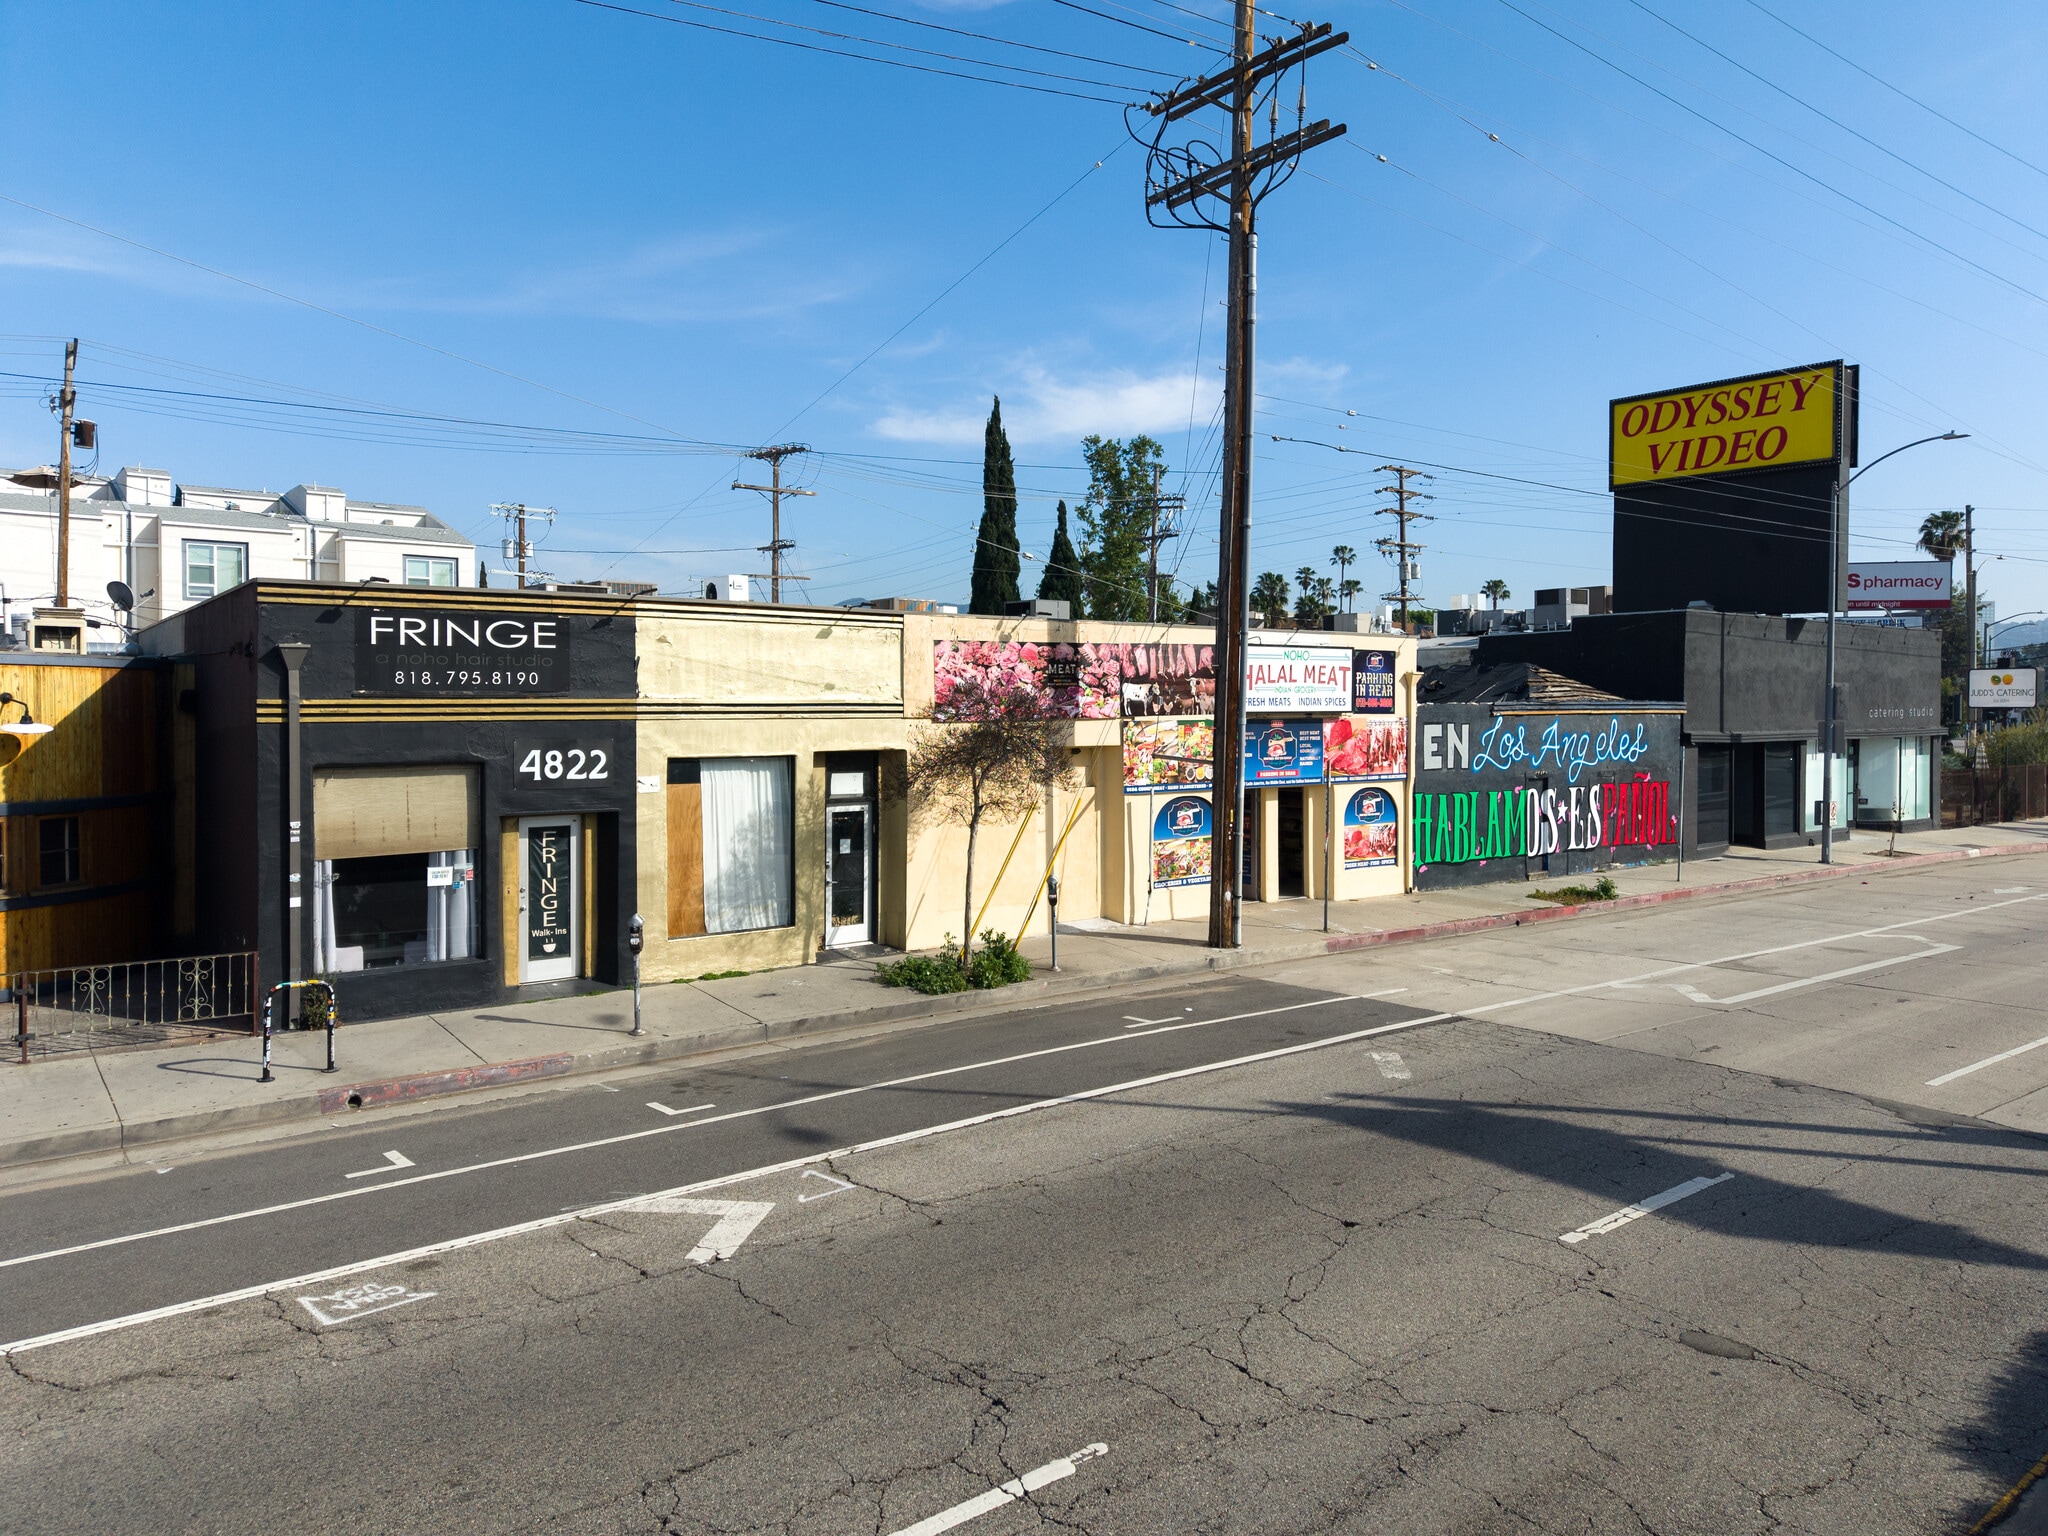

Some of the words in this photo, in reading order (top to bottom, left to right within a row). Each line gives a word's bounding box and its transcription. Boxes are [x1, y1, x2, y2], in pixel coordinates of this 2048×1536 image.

[1621, 374, 1823, 438] ODYSSEY
[1648, 425, 1788, 475] VIDEO
[1864, 575, 1944, 591] pharmacy
[1871, 601, 1901, 609] midnight
[370, 616, 557, 649] FRINGE
[375, 653, 389, 664] a
[396, 652, 450, 666] noho
[455, 653, 492, 667] hair
[498, 653, 554, 668] studio
[1283, 650, 1310, 661] NOHO
[1048, 663, 1077, 674] MEAT
[394, 670, 539, 685] 818.795.8190
[1303, 664, 1351, 692] MEAT
[1355, 672, 1393, 685] PARKING
[1294, 686, 1317, 694] GROCERY
[1355, 684, 1366, 696] IN
[1368, 685, 1393, 697] REAR
[1970, 688, 1995, 697] JUDD'S
[1996, 688, 2035, 697] CATERING
[1268, 697, 1292, 707] MEATS
[1298, 697, 1322, 707] INDIAN
[1324, 697, 1346, 707] SPICES
[1868, 707, 1904, 719] catering
[1909, 706, 1934, 717] studio
[1423, 723, 1470, 771] EN
[1472, 715, 1530, 774] Los
[1530, 715, 1649, 784] Angeles
[519, 749, 608, 781] 4822
[1412, 786, 1560, 873] HABLAMOS
[1567, 772, 1678, 850] ESPAÑOL
[540, 830, 558, 927] FRINGE
[554, 927, 567, 936] Ins
